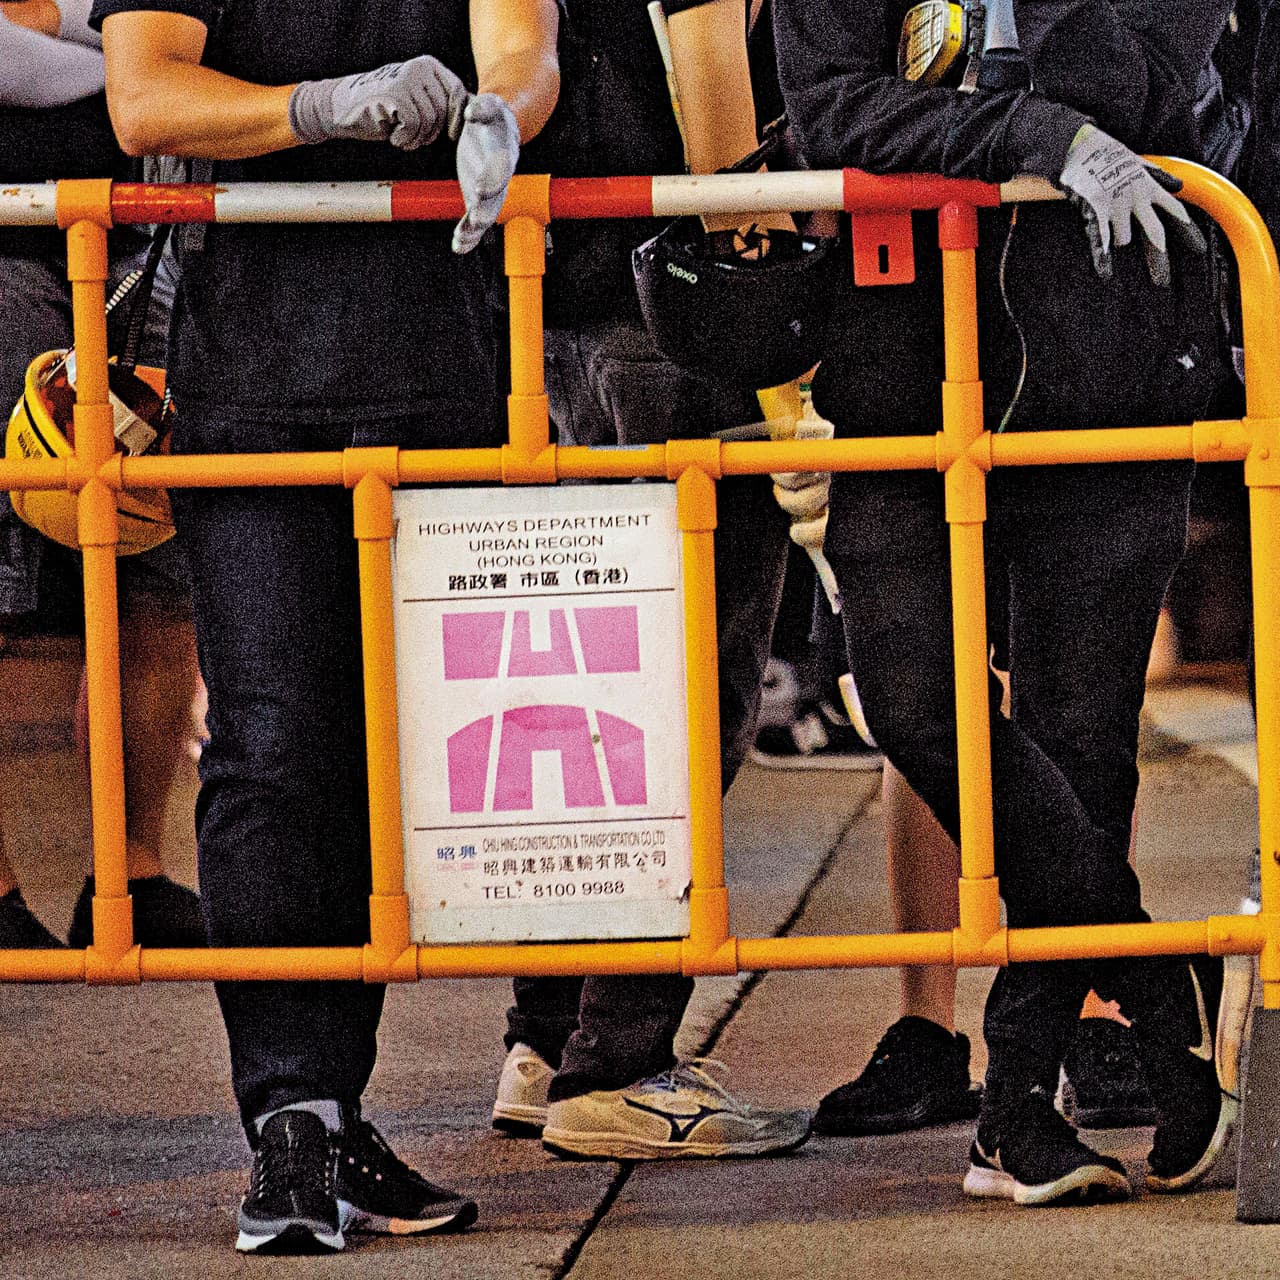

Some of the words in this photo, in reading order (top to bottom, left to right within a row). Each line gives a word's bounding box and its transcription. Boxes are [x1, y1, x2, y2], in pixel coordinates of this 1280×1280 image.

[418, 520, 518, 536] HIGHWAYS
[523, 514, 652, 532] DEPARTMENT
[468, 537, 530, 552] URBAN
[535, 535, 604, 549] REGION
[477, 554, 535, 570] (HONG
[540, 551, 598, 567] KONG)
[448, 572, 508, 591] 路政署
[520, 570, 561, 588] 市區
[483, 850, 667, 876] 昭興建築運輸有限公司
[481, 886, 521, 900] TEL:
[533, 883, 576, 898] 8100
[581, 881, 625, 896] 9988
